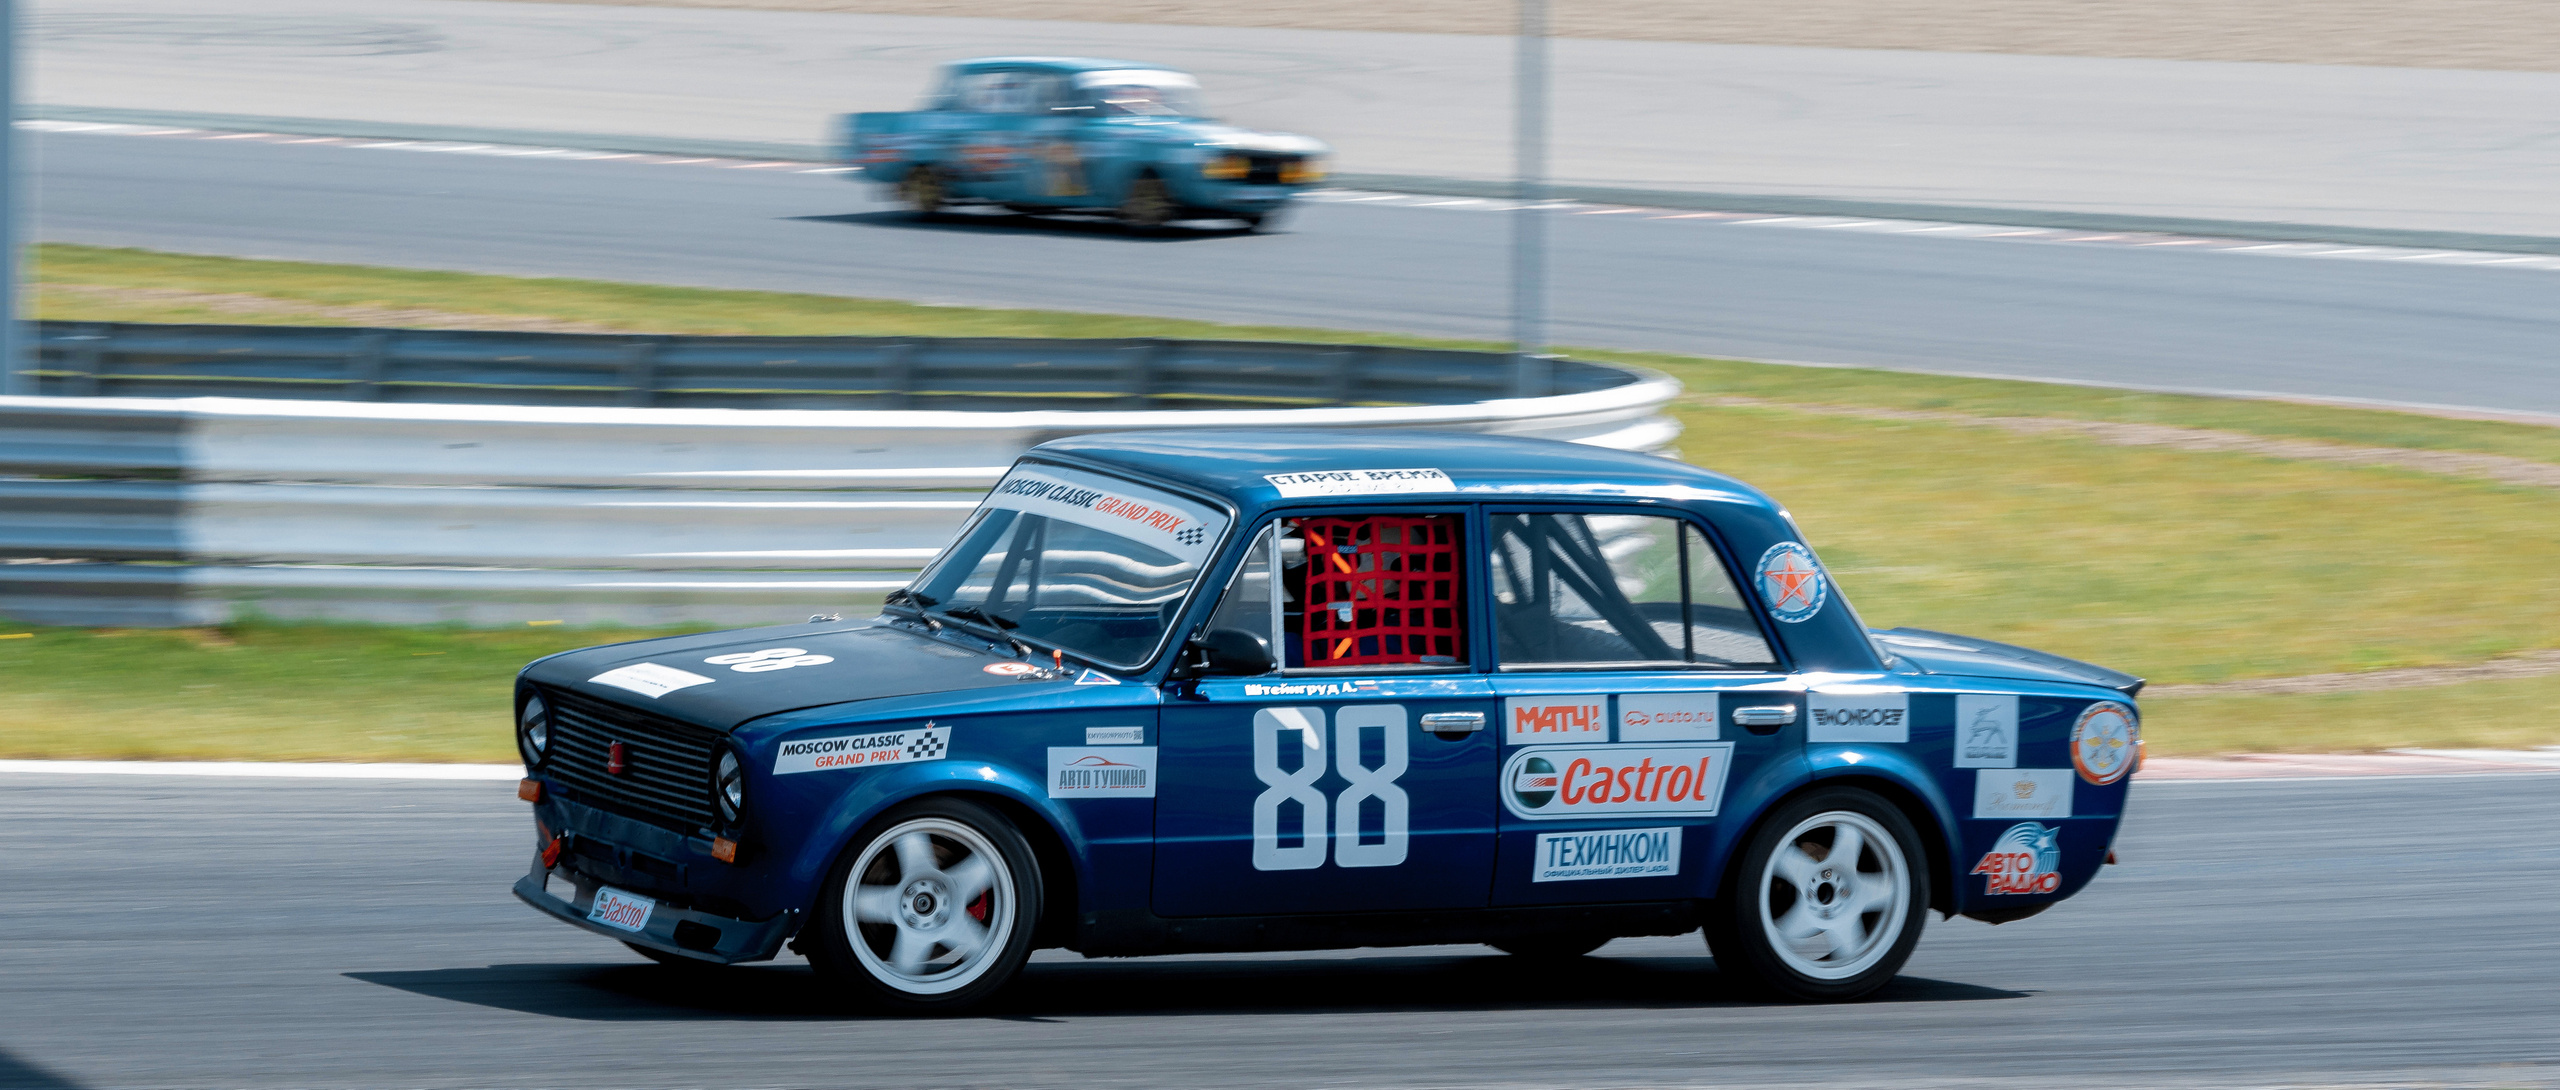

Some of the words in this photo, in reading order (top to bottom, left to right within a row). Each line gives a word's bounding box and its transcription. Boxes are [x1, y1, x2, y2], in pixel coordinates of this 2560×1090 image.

[1270, 472, 1359, 485] СТАРОЕ
[1365, 470, 1443, 480] ВРЕМЯ
[1000, 478, 1053, 498] MOSCOW
[1049, 484, 1103, 508] CLASSIC
[1094, 496, 1149, 521] GRAND
[1142, 510, 1186, 533] PRIX
[703, 648, 835, 673] 88
[1515, 705, 1600, 733] МАТЧ!
[1655, 711, 1714, 724] auto.ru
[1813, 709, 1904, 726] MONROE
[782, 740, 849, 756] MOSCOW
[851, 734, 905, 750] CLASSIC
[815, 752, 865, 768] GRAND
[870, 750, 902, 763] PRIX
[1059, 770, 1091, 788] АВТО
[1093, 769, 1146, 788] ТУШИНО
[1252, 704, 1409, 871] 88
[1561, 755, 1711, 805] Castrol
[1546, 832, 1669, 867] ТЕХИНКОМ
[1543, 866, 1613, 878] ОФИЦИАЛЬНЫЙ
[1614, 866, 1645, 875] ДИЛЕР
[1969, 852, 2033, 874] АВТО
[1984, 872, 2063, 895] РАДИО
[604, 896, 647, 928] Castrol
